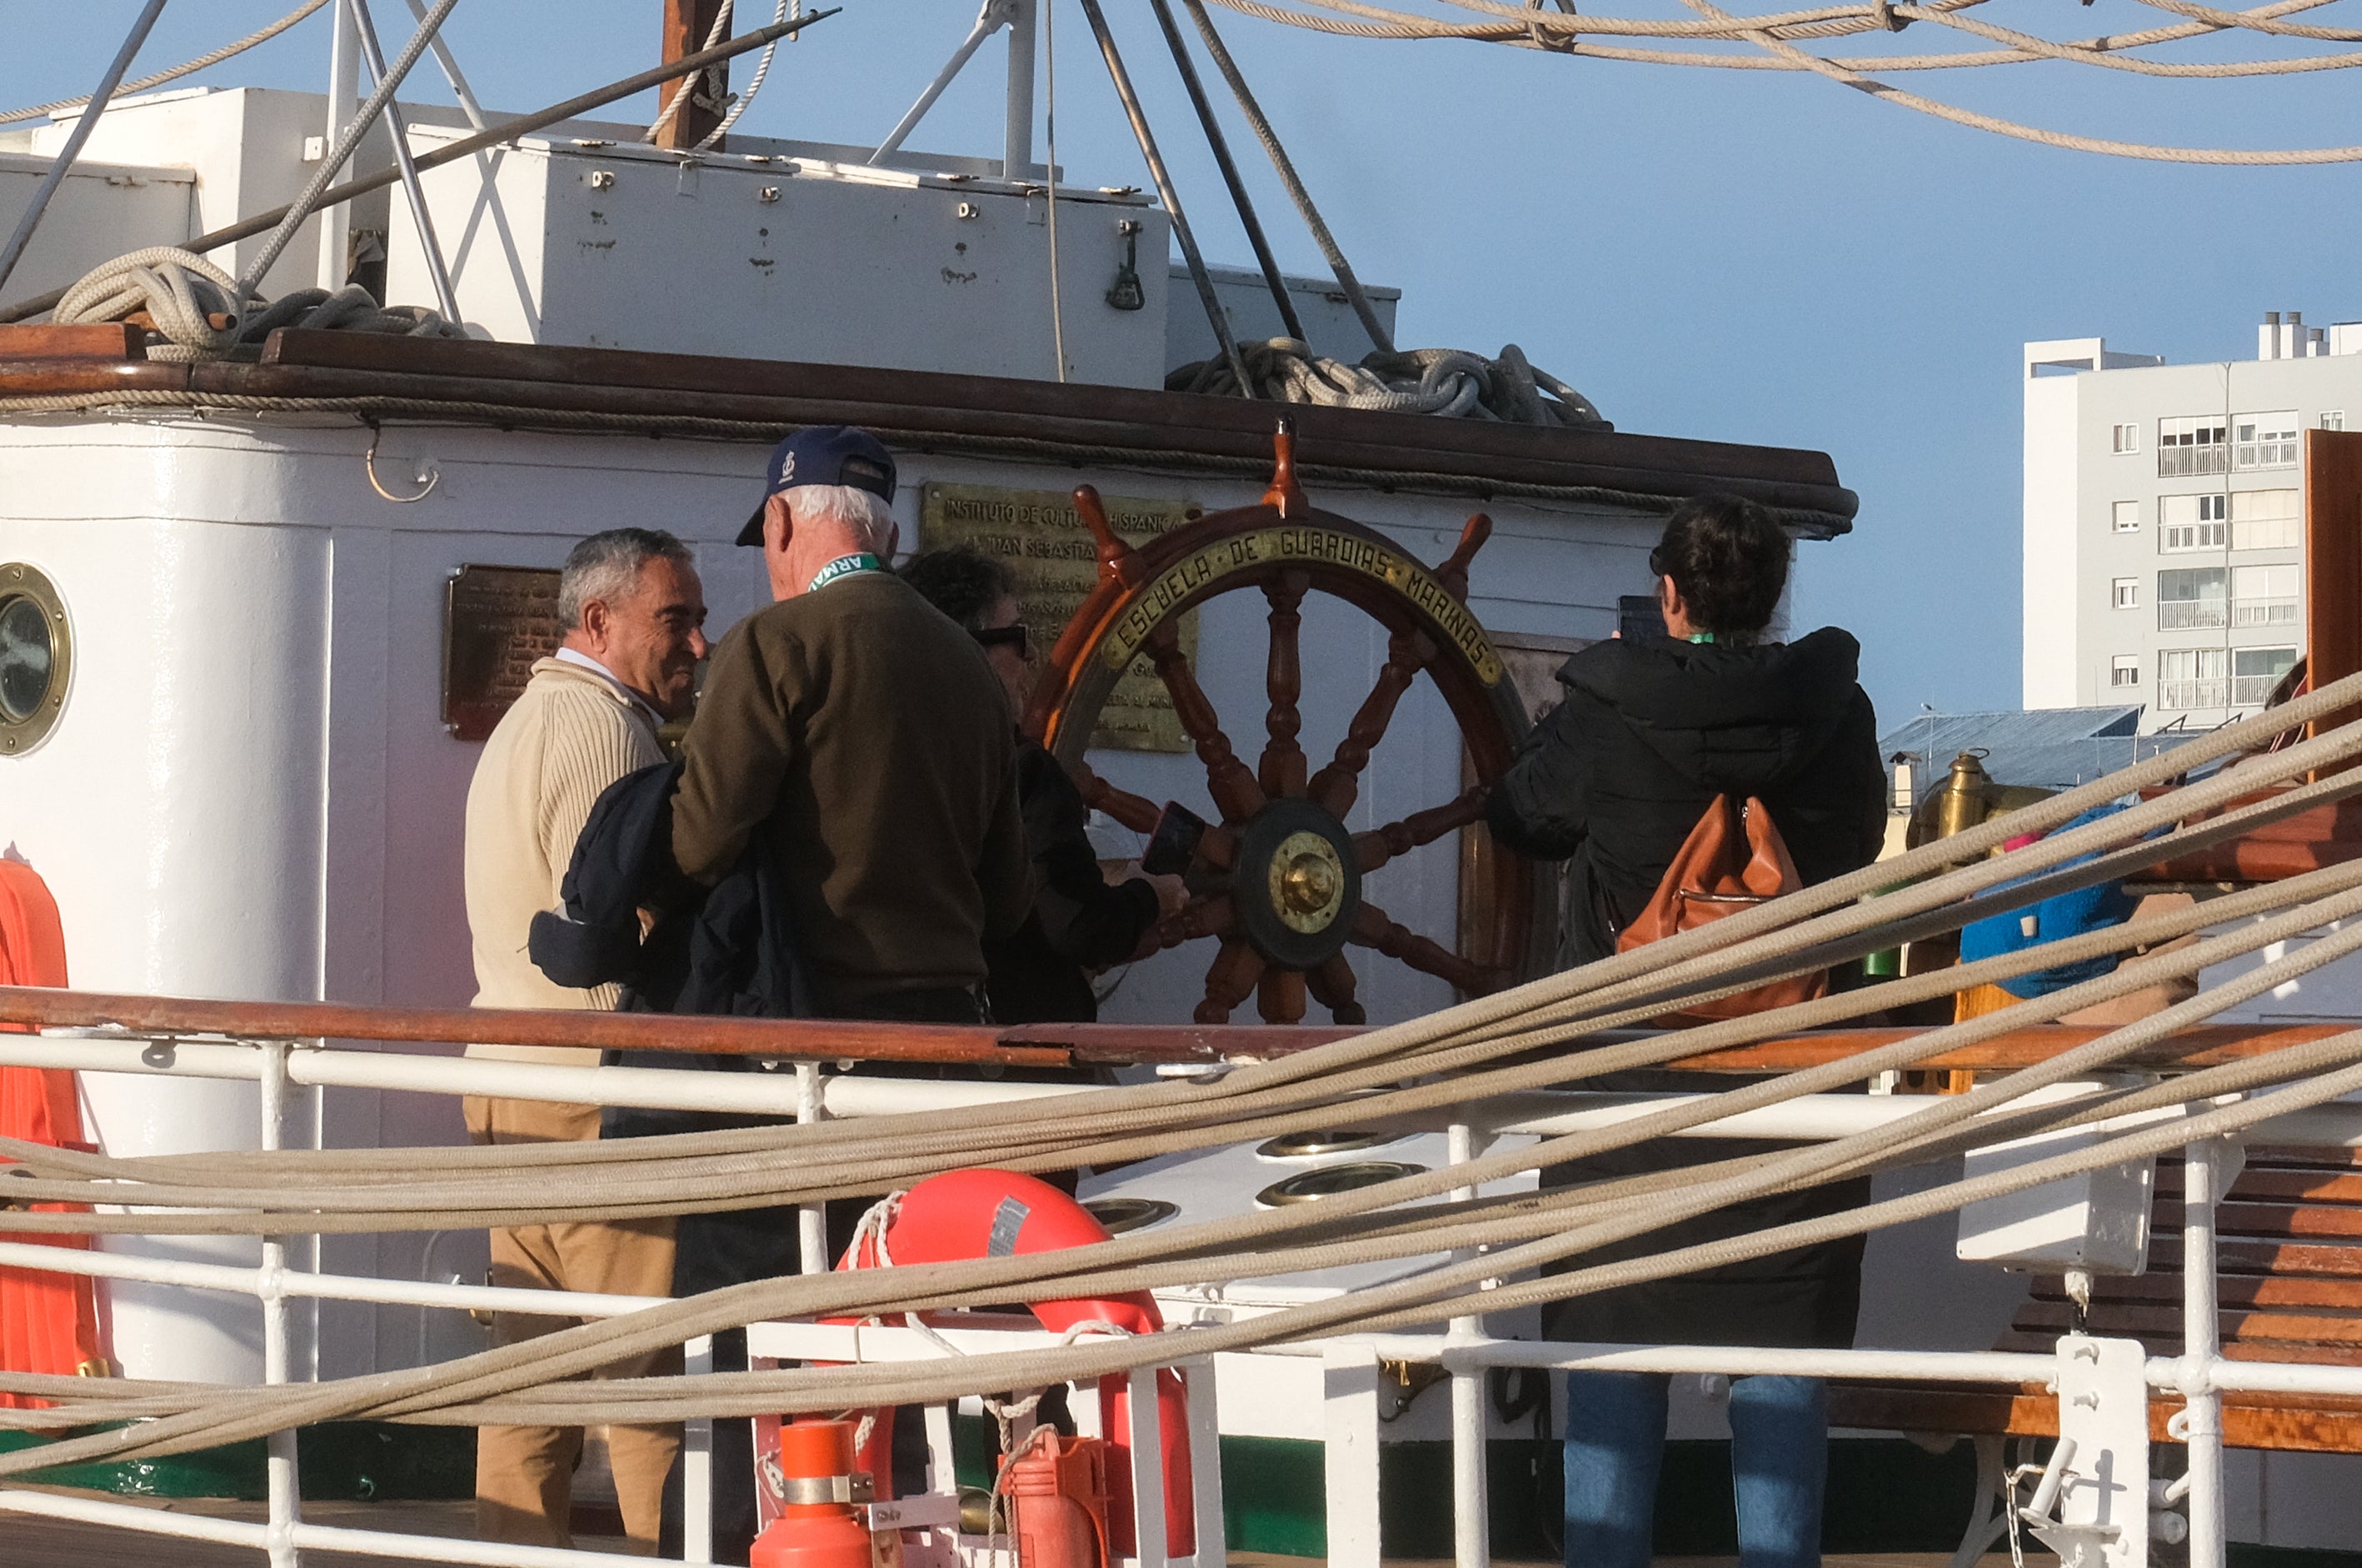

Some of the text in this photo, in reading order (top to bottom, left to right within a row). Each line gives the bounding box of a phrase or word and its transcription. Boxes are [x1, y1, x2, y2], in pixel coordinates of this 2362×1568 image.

[946, 499, 1181, 534] INSTITUTO DE CULTU HISPANICA
[1026, 537, 1098, 562] SEBASTIA
[1116, 530, 1489, 664] ESCUELA DE GUARDIAS MARINAS
